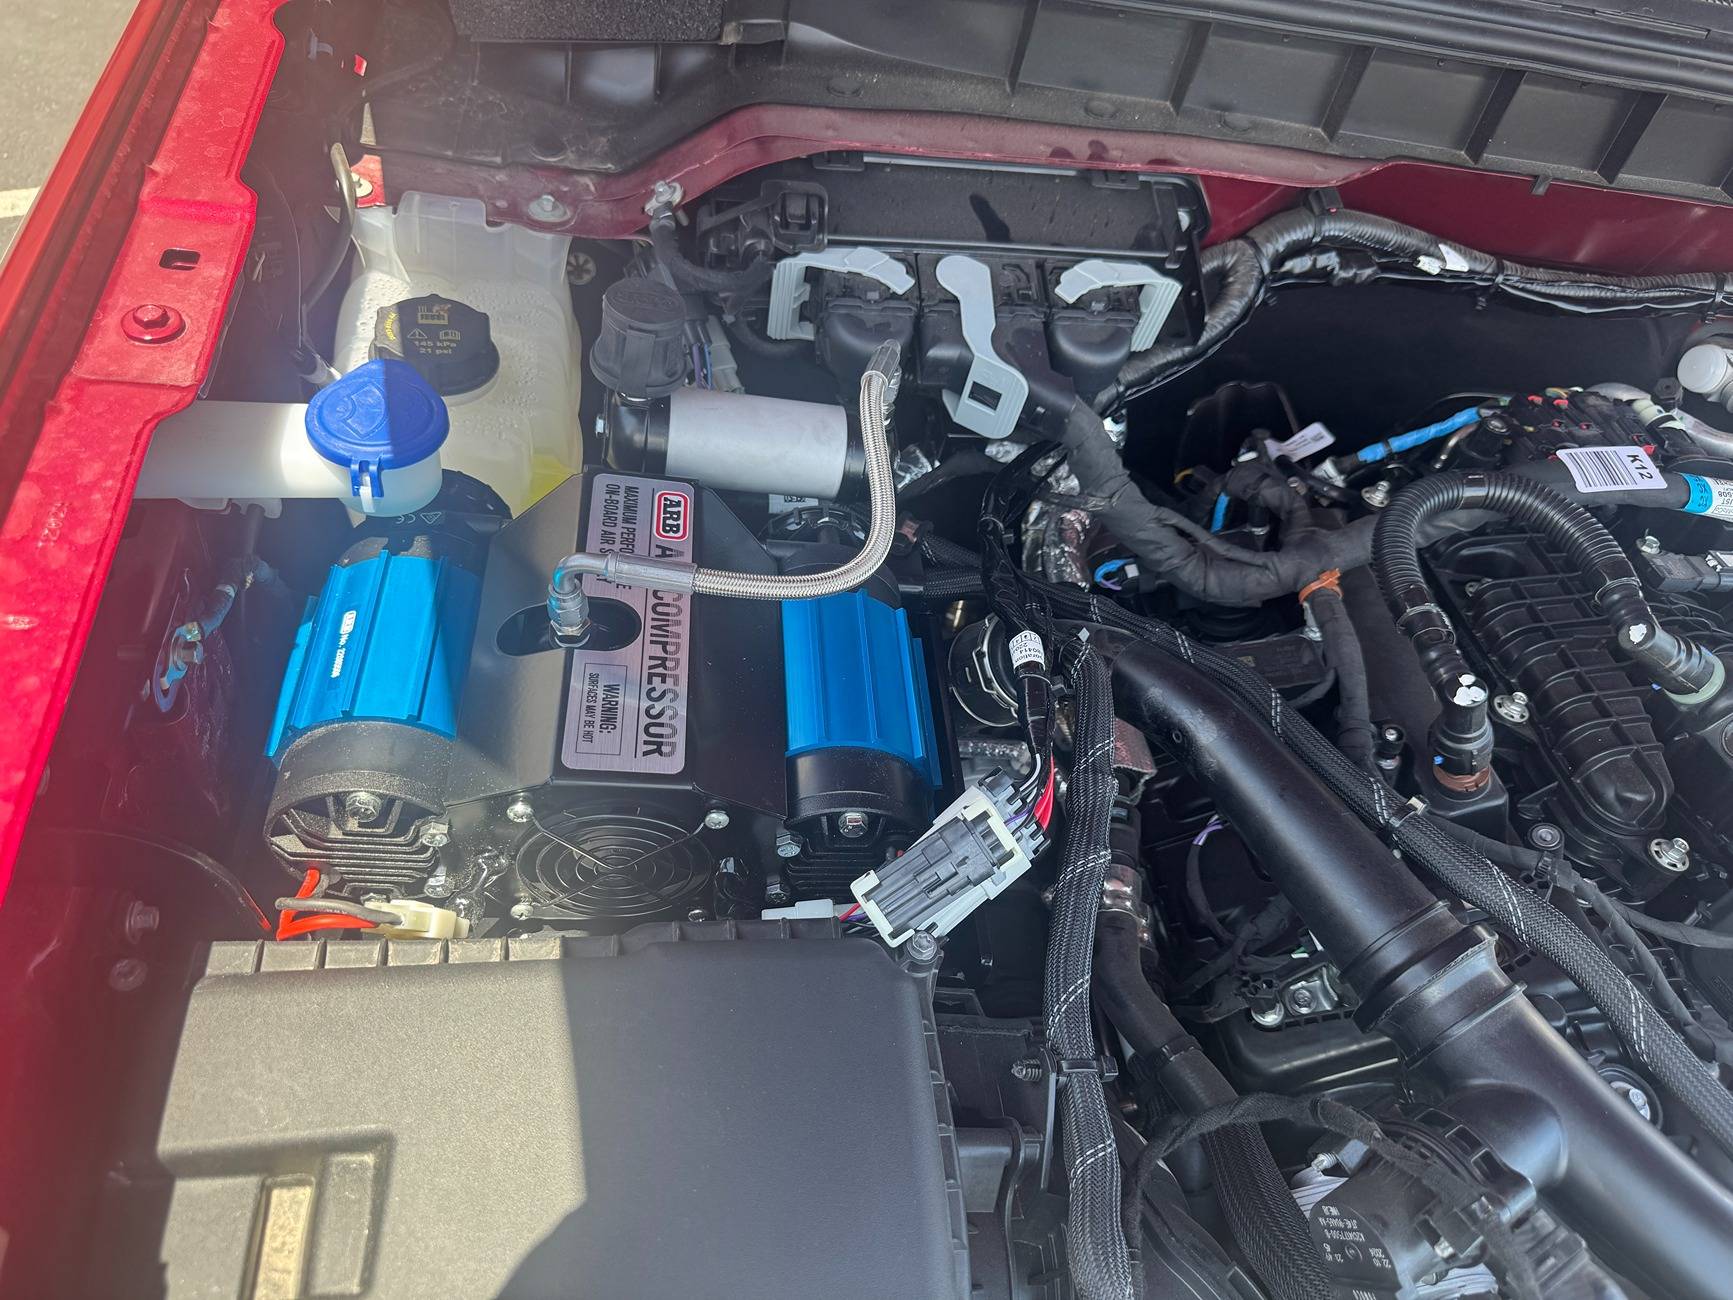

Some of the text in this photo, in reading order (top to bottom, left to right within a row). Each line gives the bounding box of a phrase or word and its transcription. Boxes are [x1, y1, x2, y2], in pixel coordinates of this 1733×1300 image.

[1626, 454, 1654, 481] K12
[602, 483, 621, 528] ON-BOARD
[621, 485, 640, 525] MAXIMUM
[661, 496, 682, 536] ARB
[600, 529, 617, 545] AIR
[642, 589, 684, 758] COMPRESSOR
[581, 672, 600, 744] SURFACES MAY BE HOT
[598, 683, 621, 734] WARNING:
